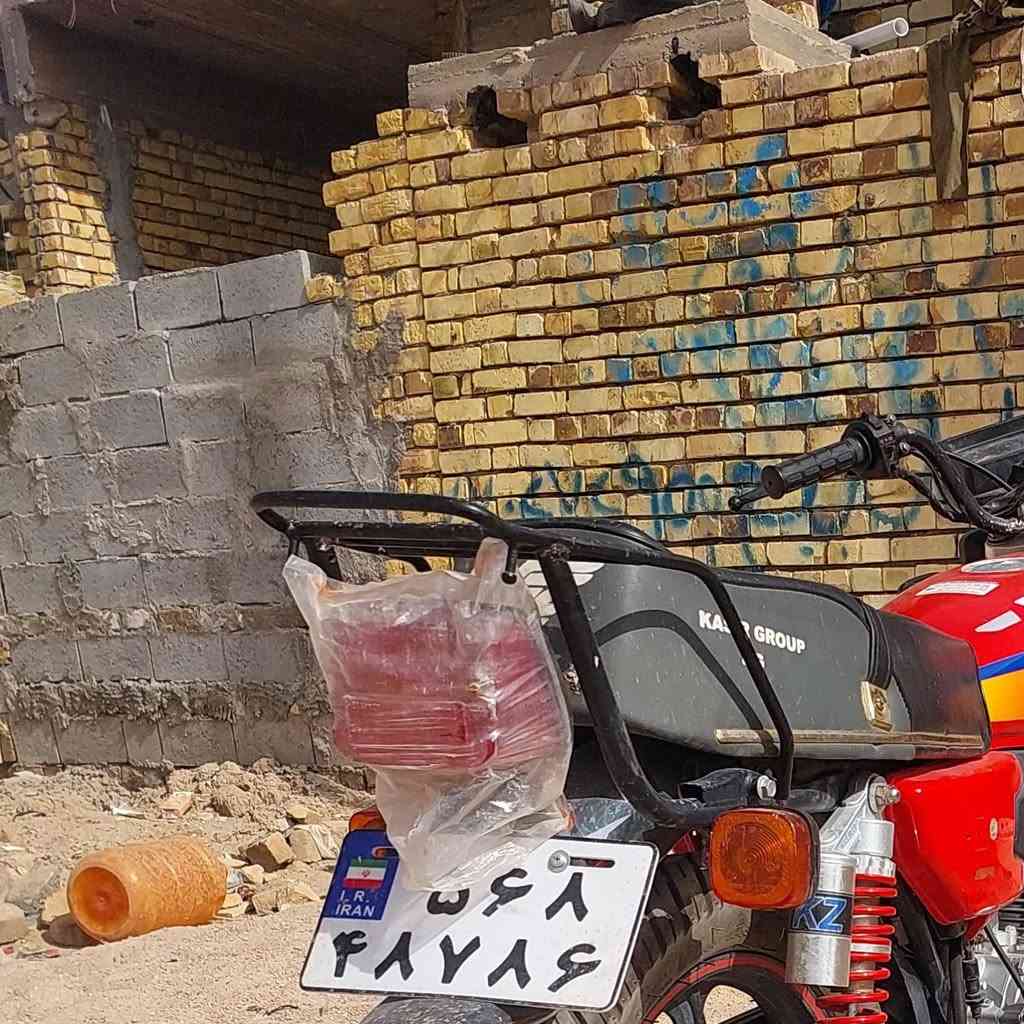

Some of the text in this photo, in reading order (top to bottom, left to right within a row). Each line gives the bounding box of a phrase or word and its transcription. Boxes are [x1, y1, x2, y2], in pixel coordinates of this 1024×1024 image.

[753, 625, 806, 654] GROUP
[335, 903, 376, 917] IRAN
[332, 929, 602, 993] ۴۸۷۸۶
